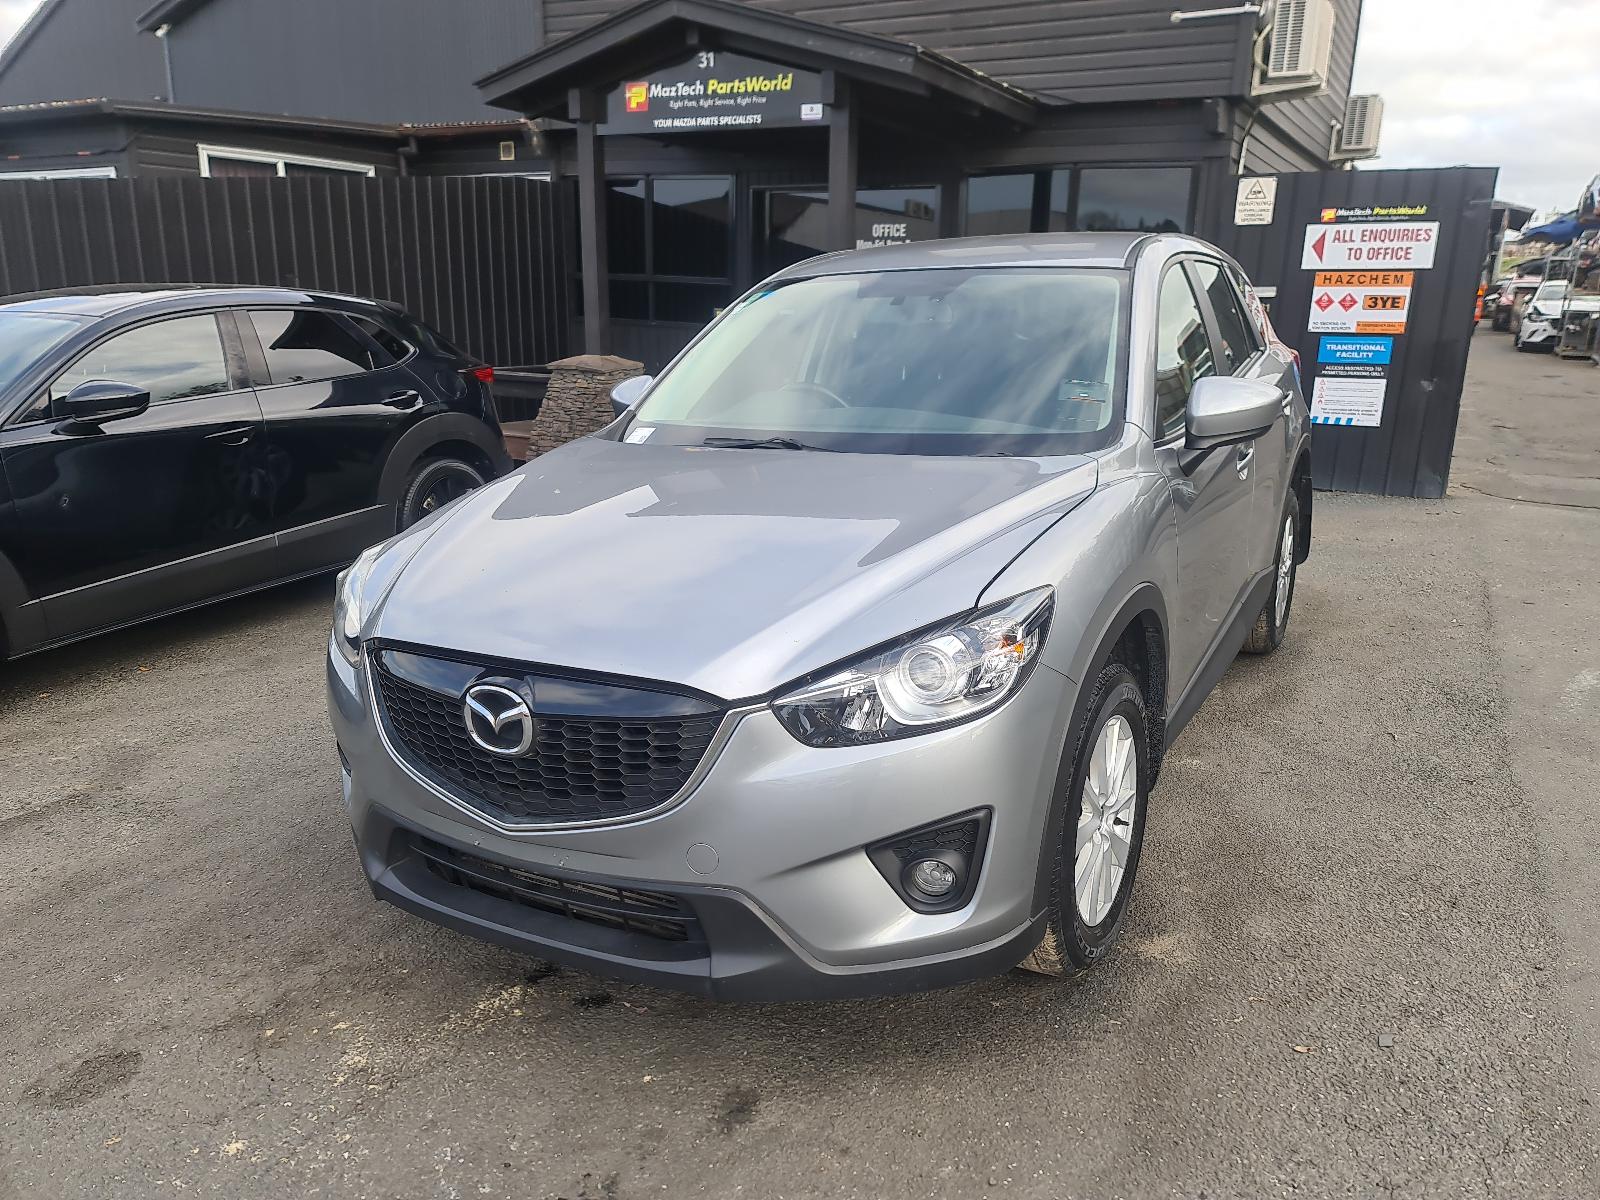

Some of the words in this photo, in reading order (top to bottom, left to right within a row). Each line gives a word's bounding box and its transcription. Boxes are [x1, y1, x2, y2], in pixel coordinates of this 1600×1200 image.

[698, 52, 714, 68] 31
[649, 80, 704, 98] MazTech
[707, 73, 793, 95] PartsWorld
[653, 117, 672, 128] YOUR
[673, 117, 696, 127] MAZDA
[697, 116, 718, 126] PARTS
[719, 114, 762, 125] SPECIALISTS
[872, 224, 907, 237] OFFICE
[1332, 229, 1356, 243] ALL
[1360, 228, 1433, 243] ENQUIRIES
[1346, 247, 1362, 261] TO
[1367, 246, 1414, 261] OFFICE
[1322, 274, 1404, 285] HAZCHEM
[1368, 296, 1401, 309] 3YE
[1325, 343, 1386, 352] TRANSITIONAL
